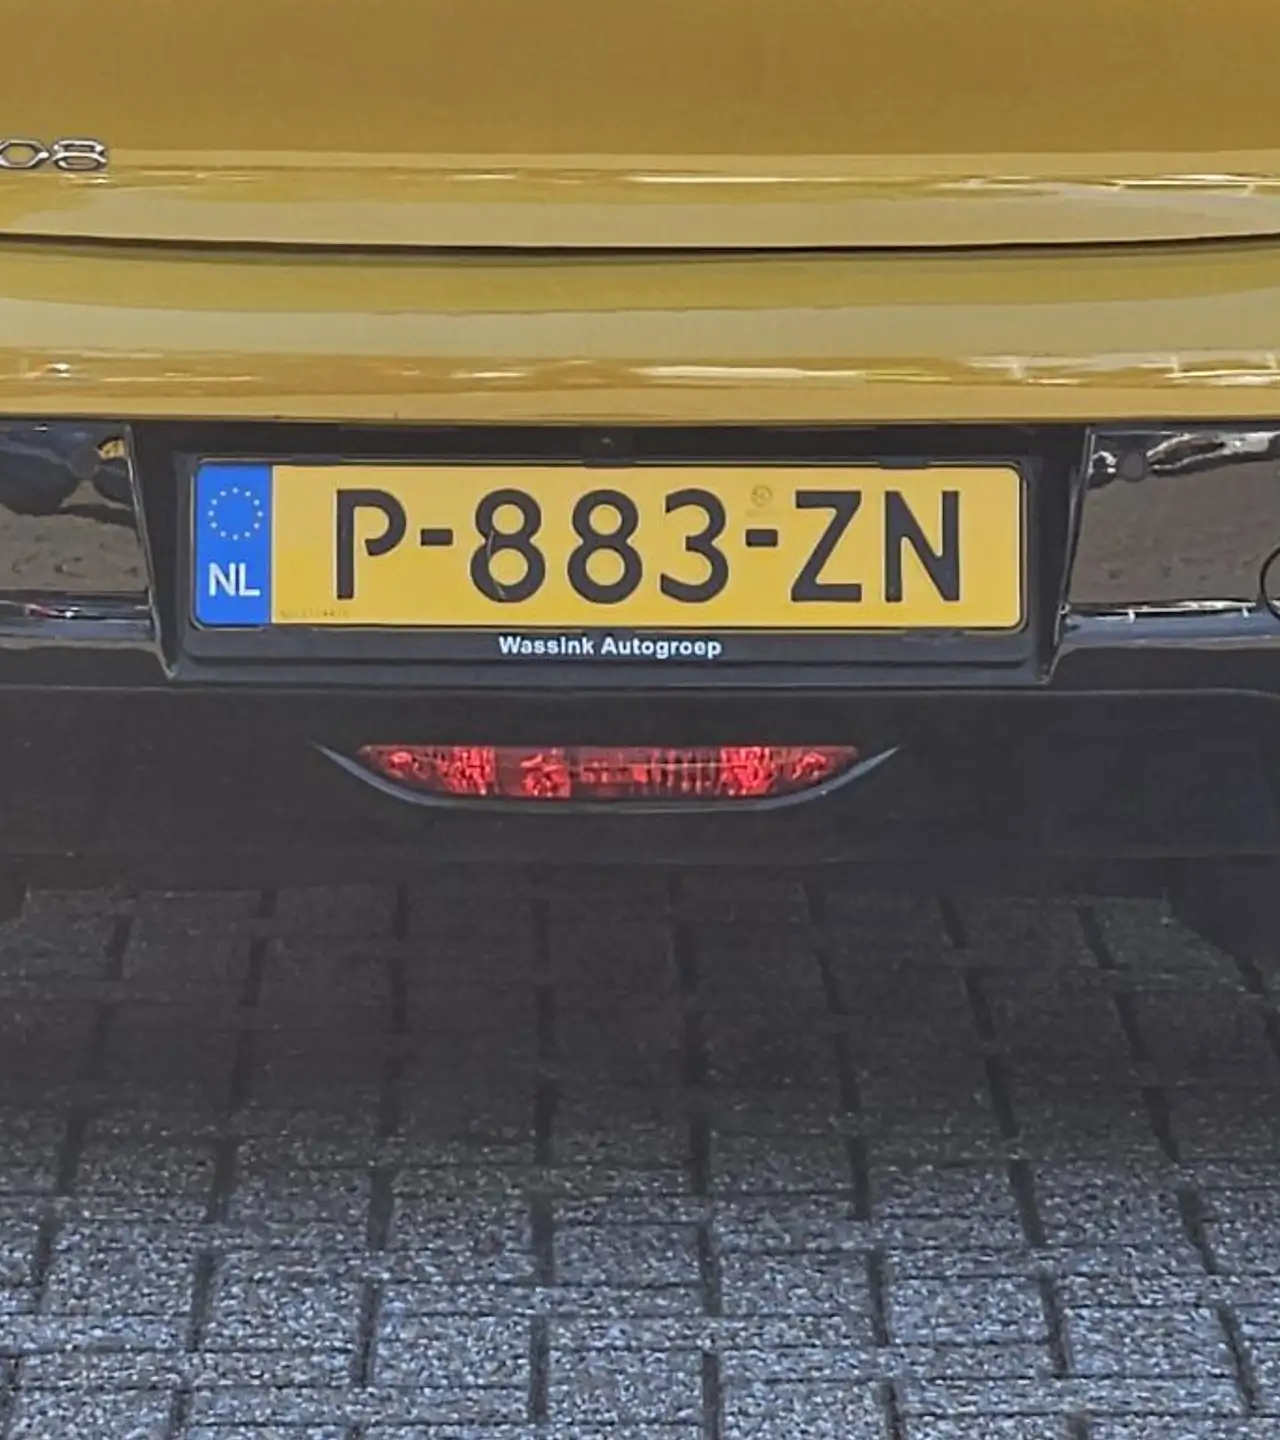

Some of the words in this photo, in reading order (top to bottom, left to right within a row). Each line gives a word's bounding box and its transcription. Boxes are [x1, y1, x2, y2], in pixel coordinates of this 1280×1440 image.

[335, 488, 961, 604] P-883-ZN
[208, 562, 261, 597] NL
[498, 635, 595, 656] Wassink
[600, 635, 722, 660] Autogroep
